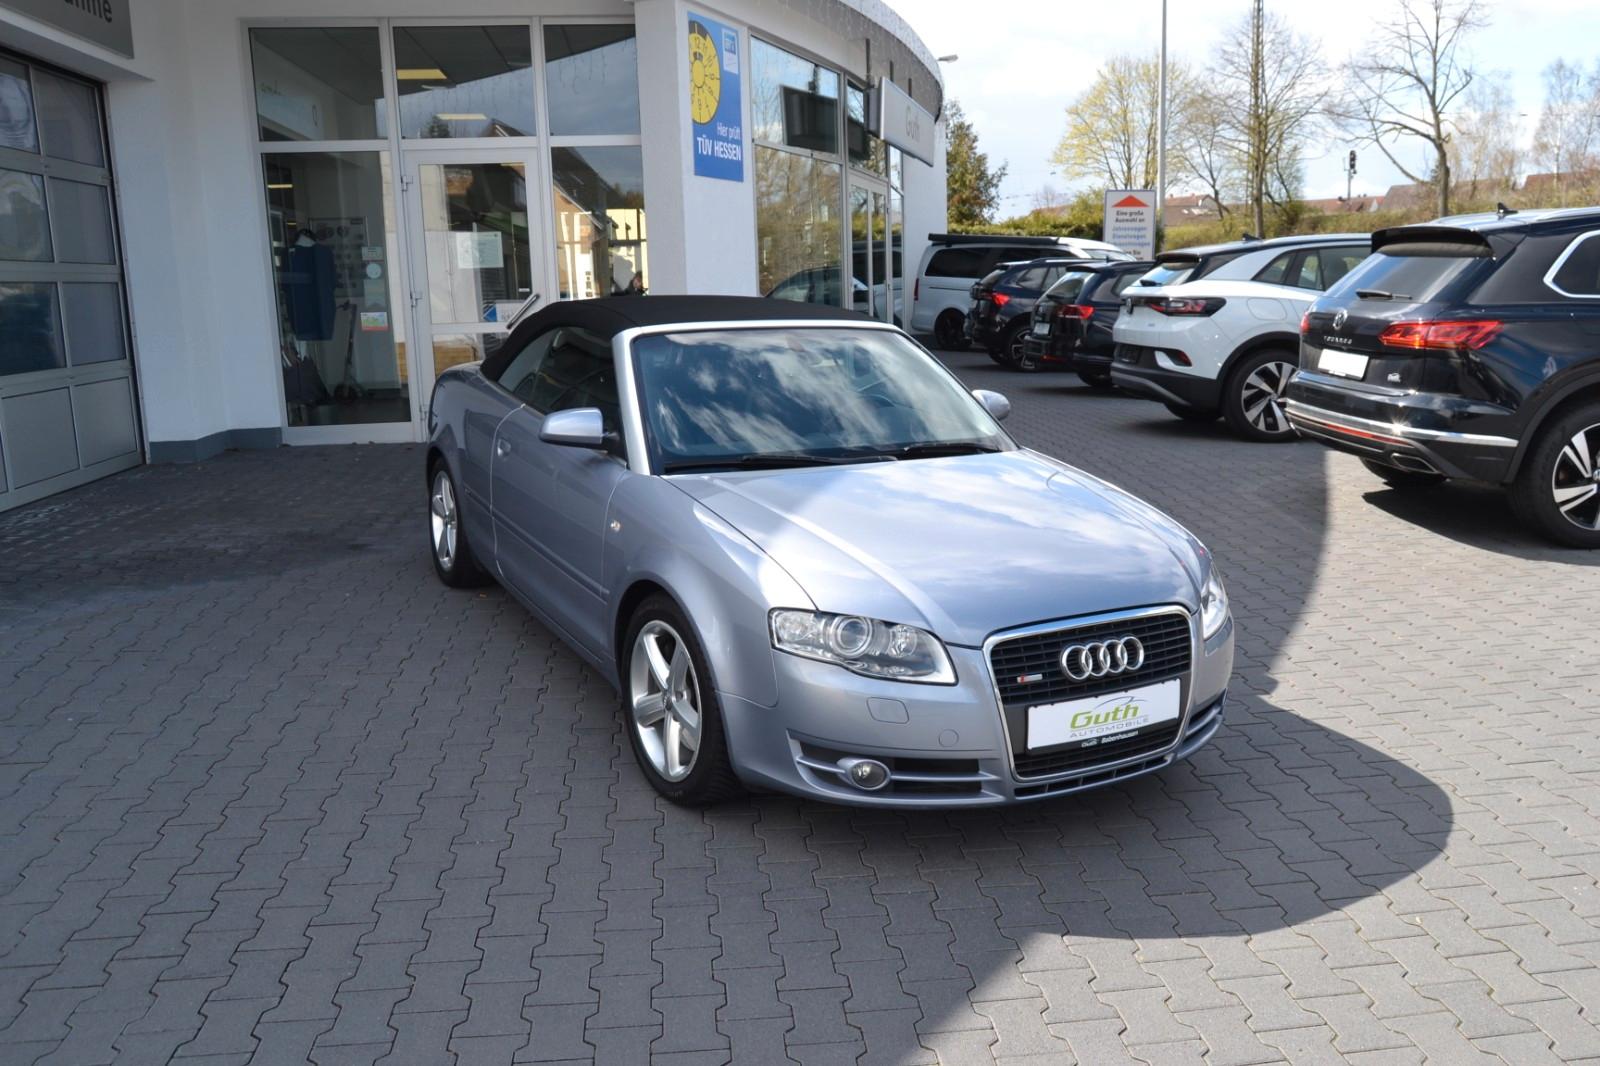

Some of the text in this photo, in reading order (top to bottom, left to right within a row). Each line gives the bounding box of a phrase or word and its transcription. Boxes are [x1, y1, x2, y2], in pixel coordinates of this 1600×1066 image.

[717, 122, 728, 137] Hier
[697, 134, 741, 161] TÜV HESSEN
[1070, 704, 1139, 729] Guth
[1070, 715, 1149, 738] AUTOMOBILE
